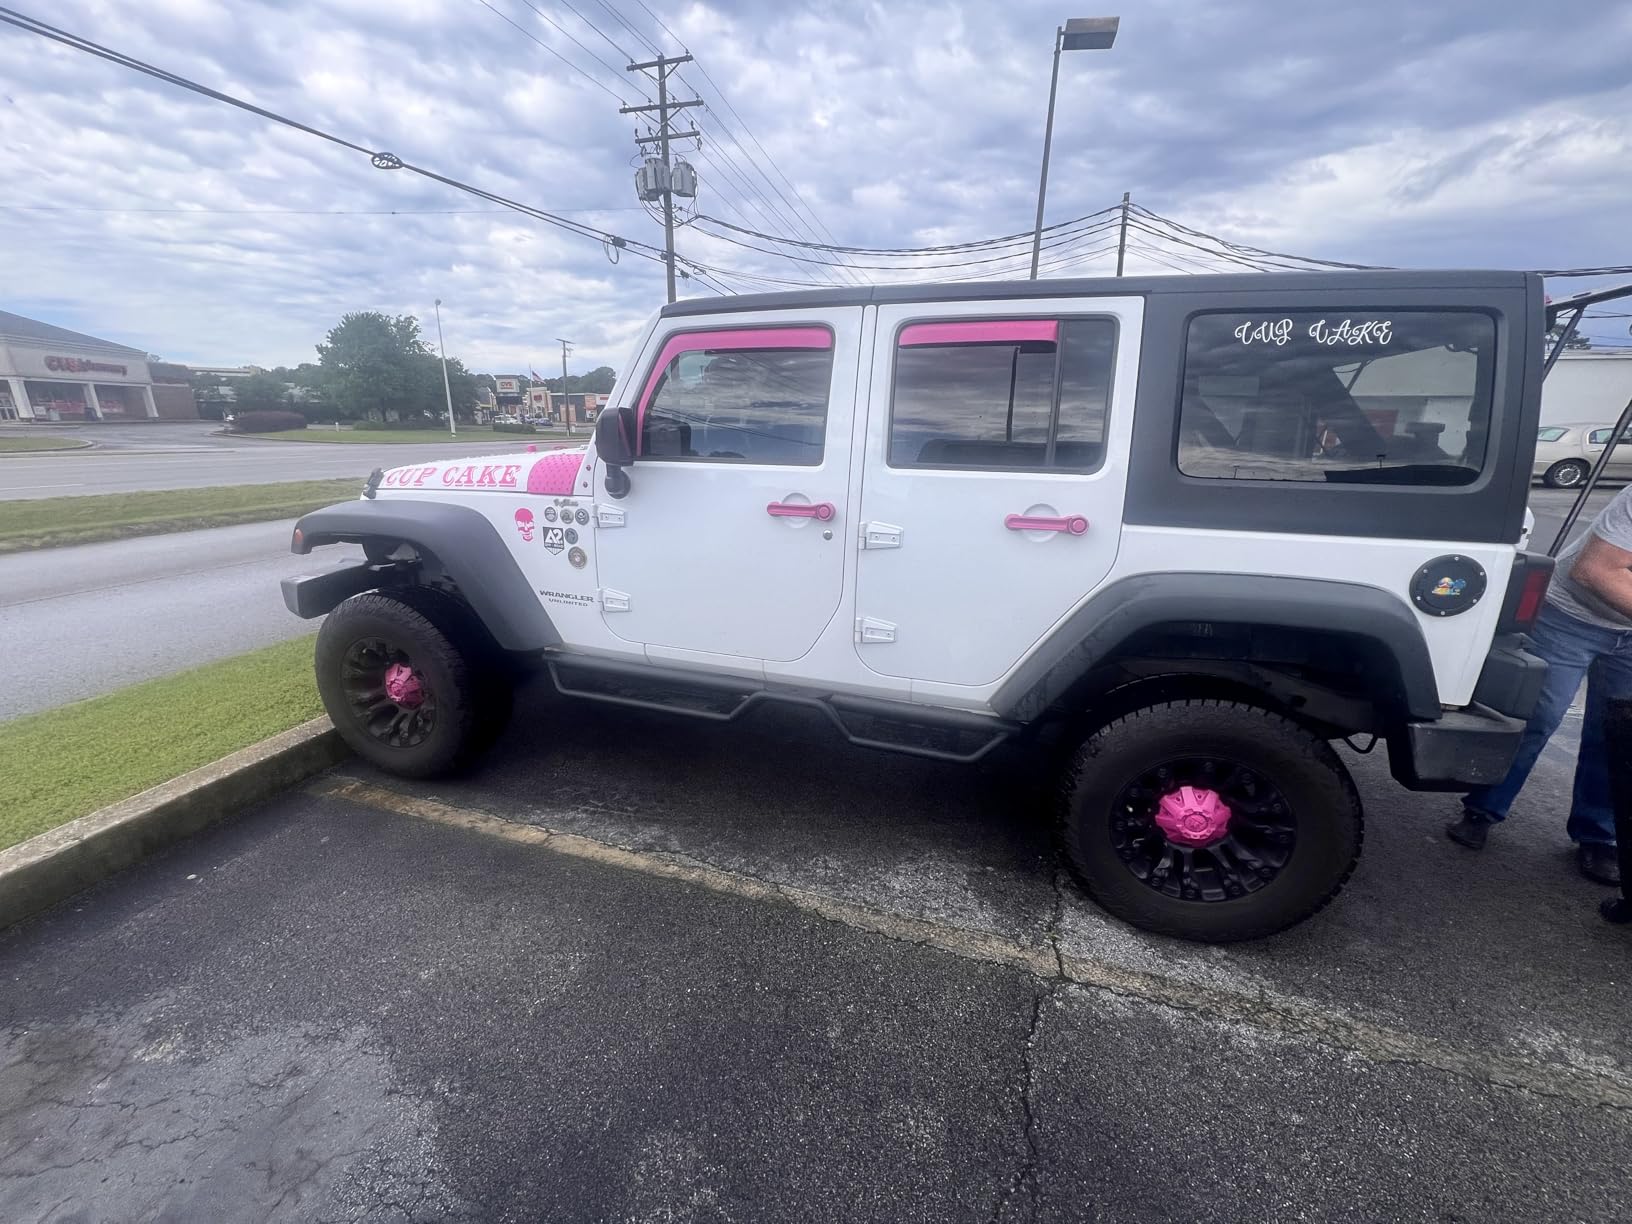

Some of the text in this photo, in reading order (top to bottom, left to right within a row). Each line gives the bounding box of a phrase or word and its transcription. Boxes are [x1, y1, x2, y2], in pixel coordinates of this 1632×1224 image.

[1234, 318, 1392, 345] CUP CAKE
[386, 465, 522, 488] CUP CAKE
[539, 590, 594, 603] WRANGLER
[548, 598, 588, 607] UNLIMITED
